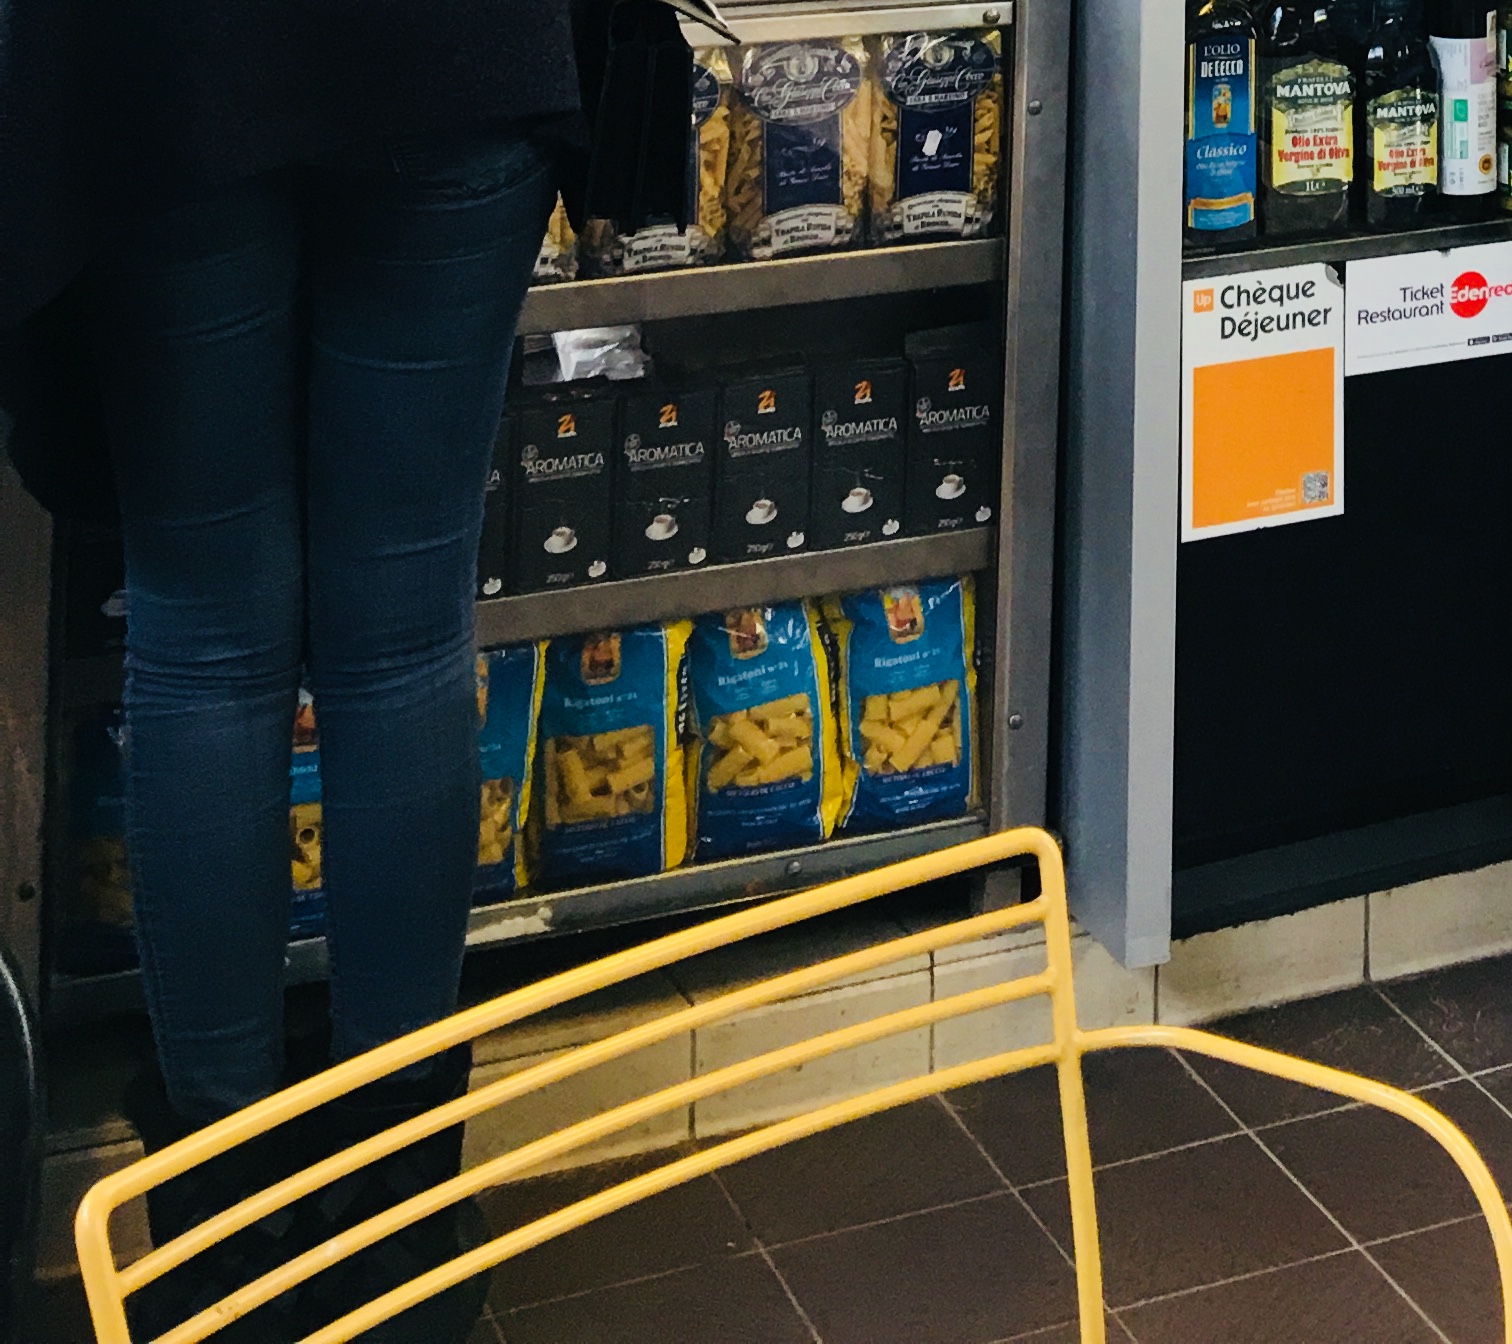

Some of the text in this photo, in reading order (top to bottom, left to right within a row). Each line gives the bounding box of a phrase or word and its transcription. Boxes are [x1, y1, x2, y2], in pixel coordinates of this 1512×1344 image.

[1201, 60, 1244, 78] DE CECCO
[1276, 81, 1351, 98] MANTOVA
[1376, 103, 1436, 118] MANTOVA
[1196, 143, 1247, 160] Classico
[1291, 134, 1338, 148] Olio Extra
[1278, 149, 1315, 164] Vergine
[1317, 148, 1326, 159] di
[1195, 279, 1316, 313] Up Chèque
[1400, 283, 1445, 303] Ticket
[1220, 306, 1333, 342] Déjeuner
[1357, 301, 1445, 326] Restaurant
[919, 405, 990, 426] AROMATICA
[727, 427, 802, 450] AROMATICA
[825, 417, 898, 439] AROMATICA
[629, 441, 705, 463] AROMATICA
[526, 453, 604, 475] AROMATICA
[874, 650, 921, 668] Rigatoni
[718, 665, 766, 687] Rigatoni
